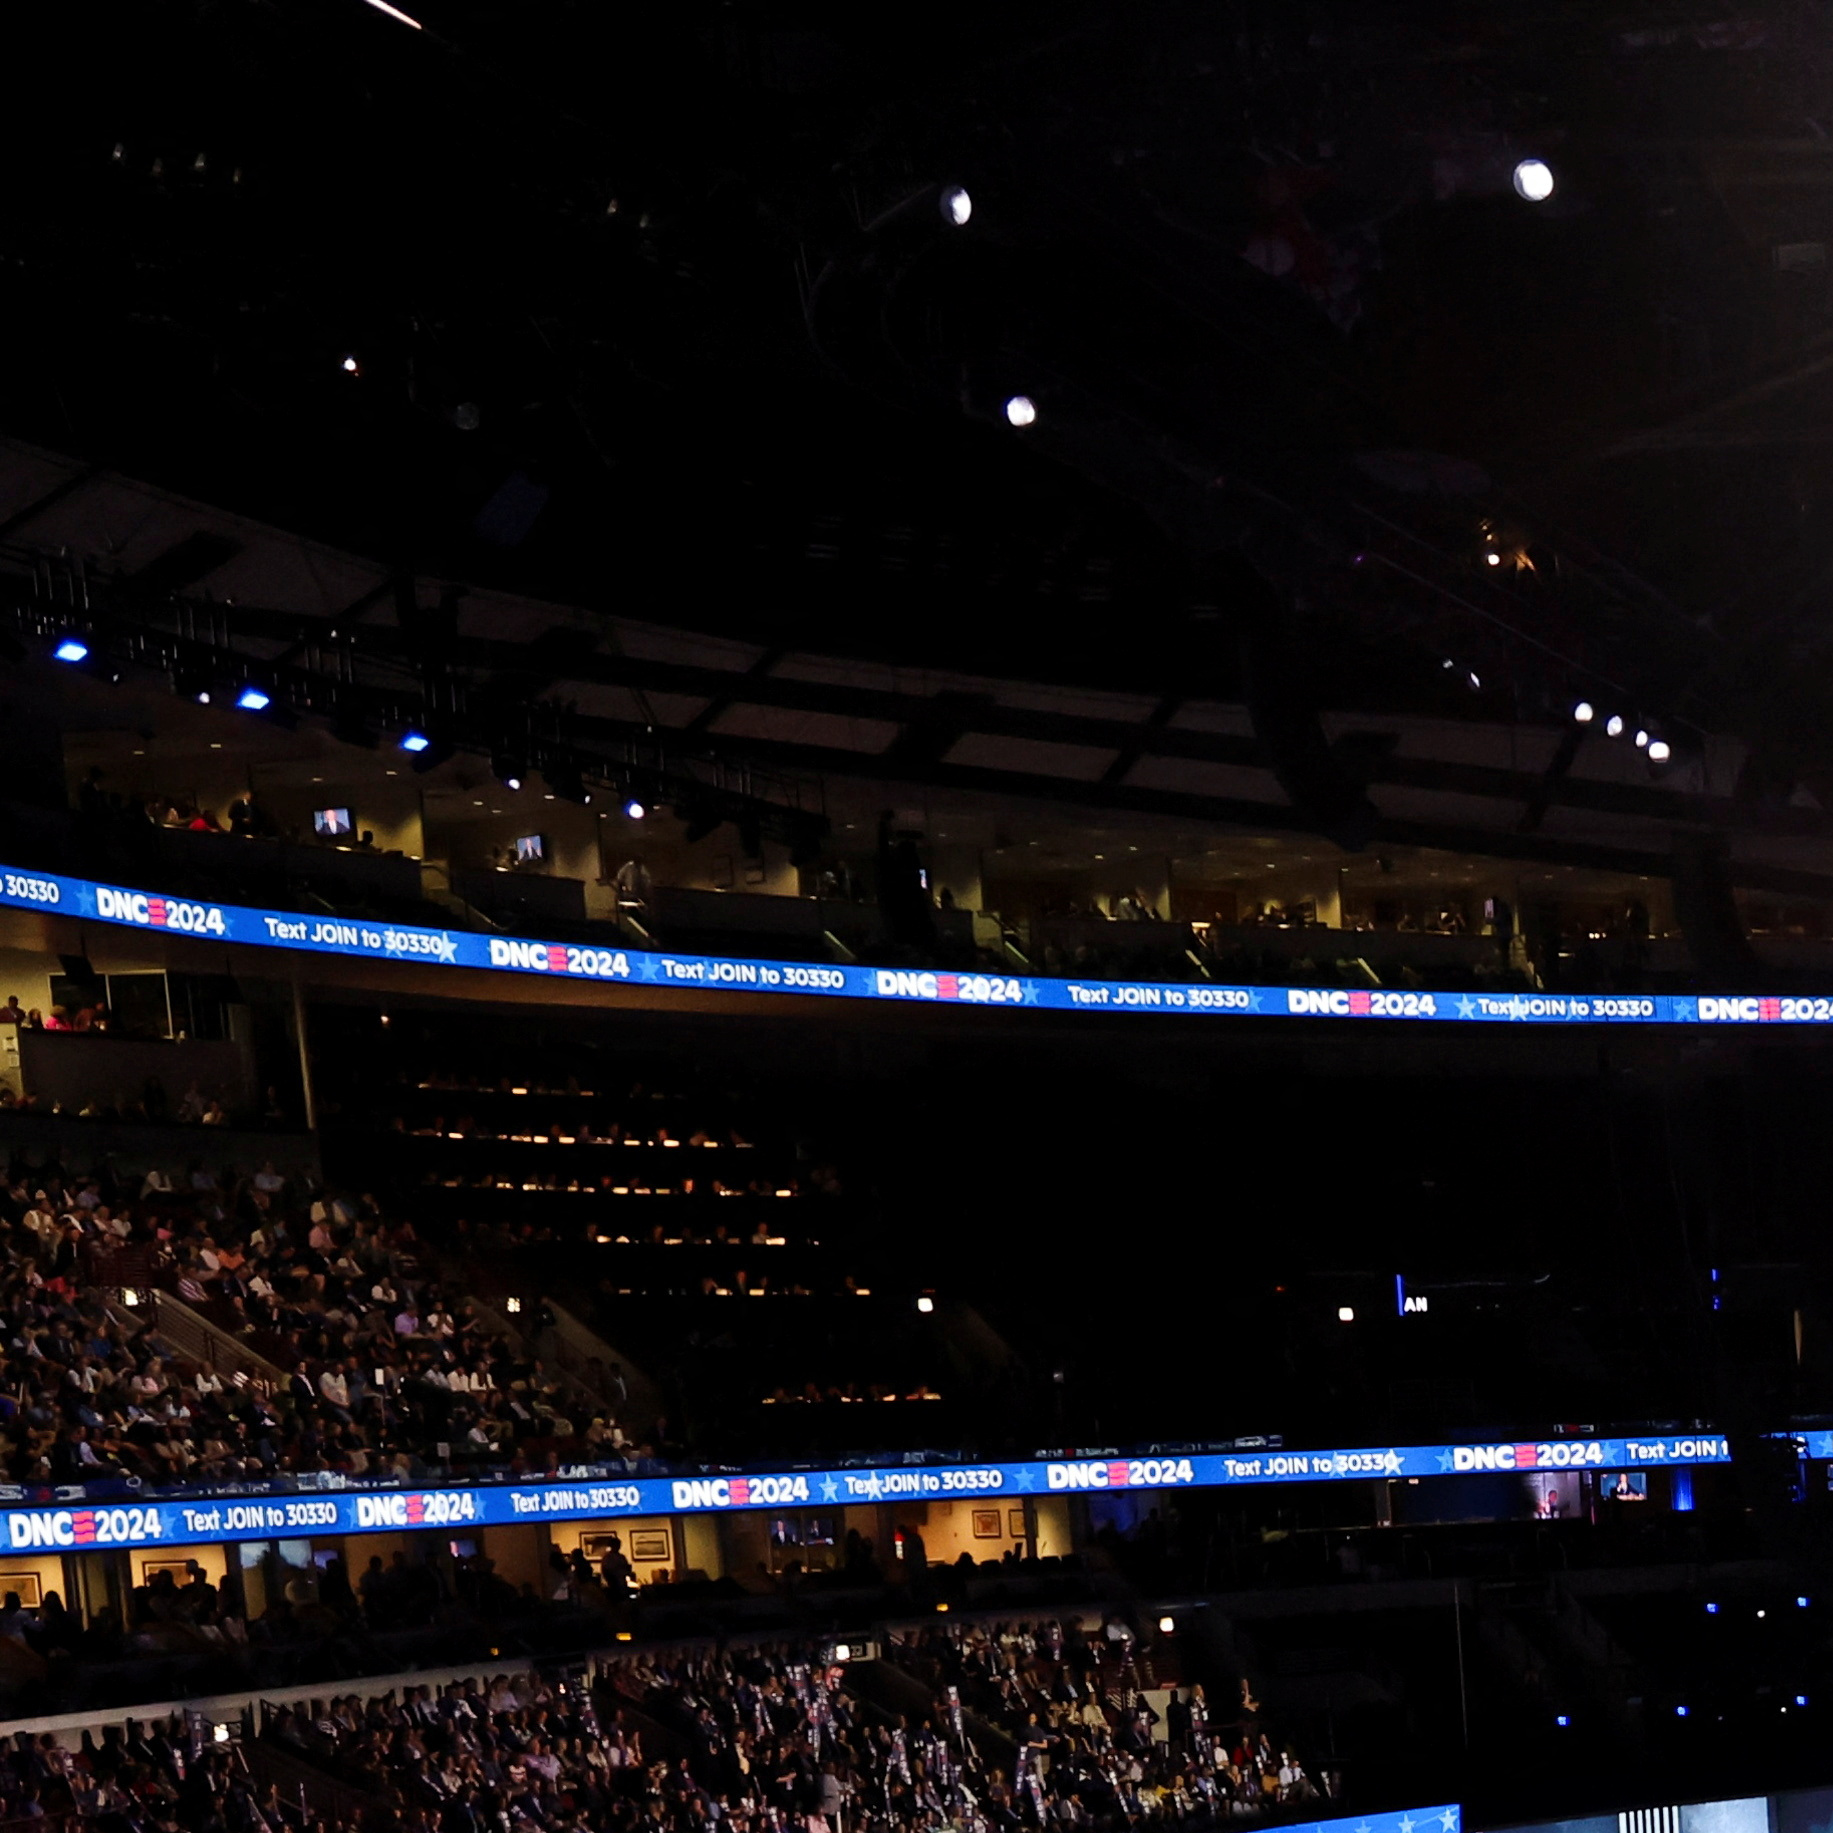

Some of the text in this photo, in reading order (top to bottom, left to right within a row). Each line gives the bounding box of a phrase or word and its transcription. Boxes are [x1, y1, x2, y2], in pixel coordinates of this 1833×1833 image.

[265, 918, 442, 957] Text JOIN to 30330
[662, 960, 829, 986] Text JOIN to 30330
[184, 1502, 336, 1531] Text JOIN to 30330
